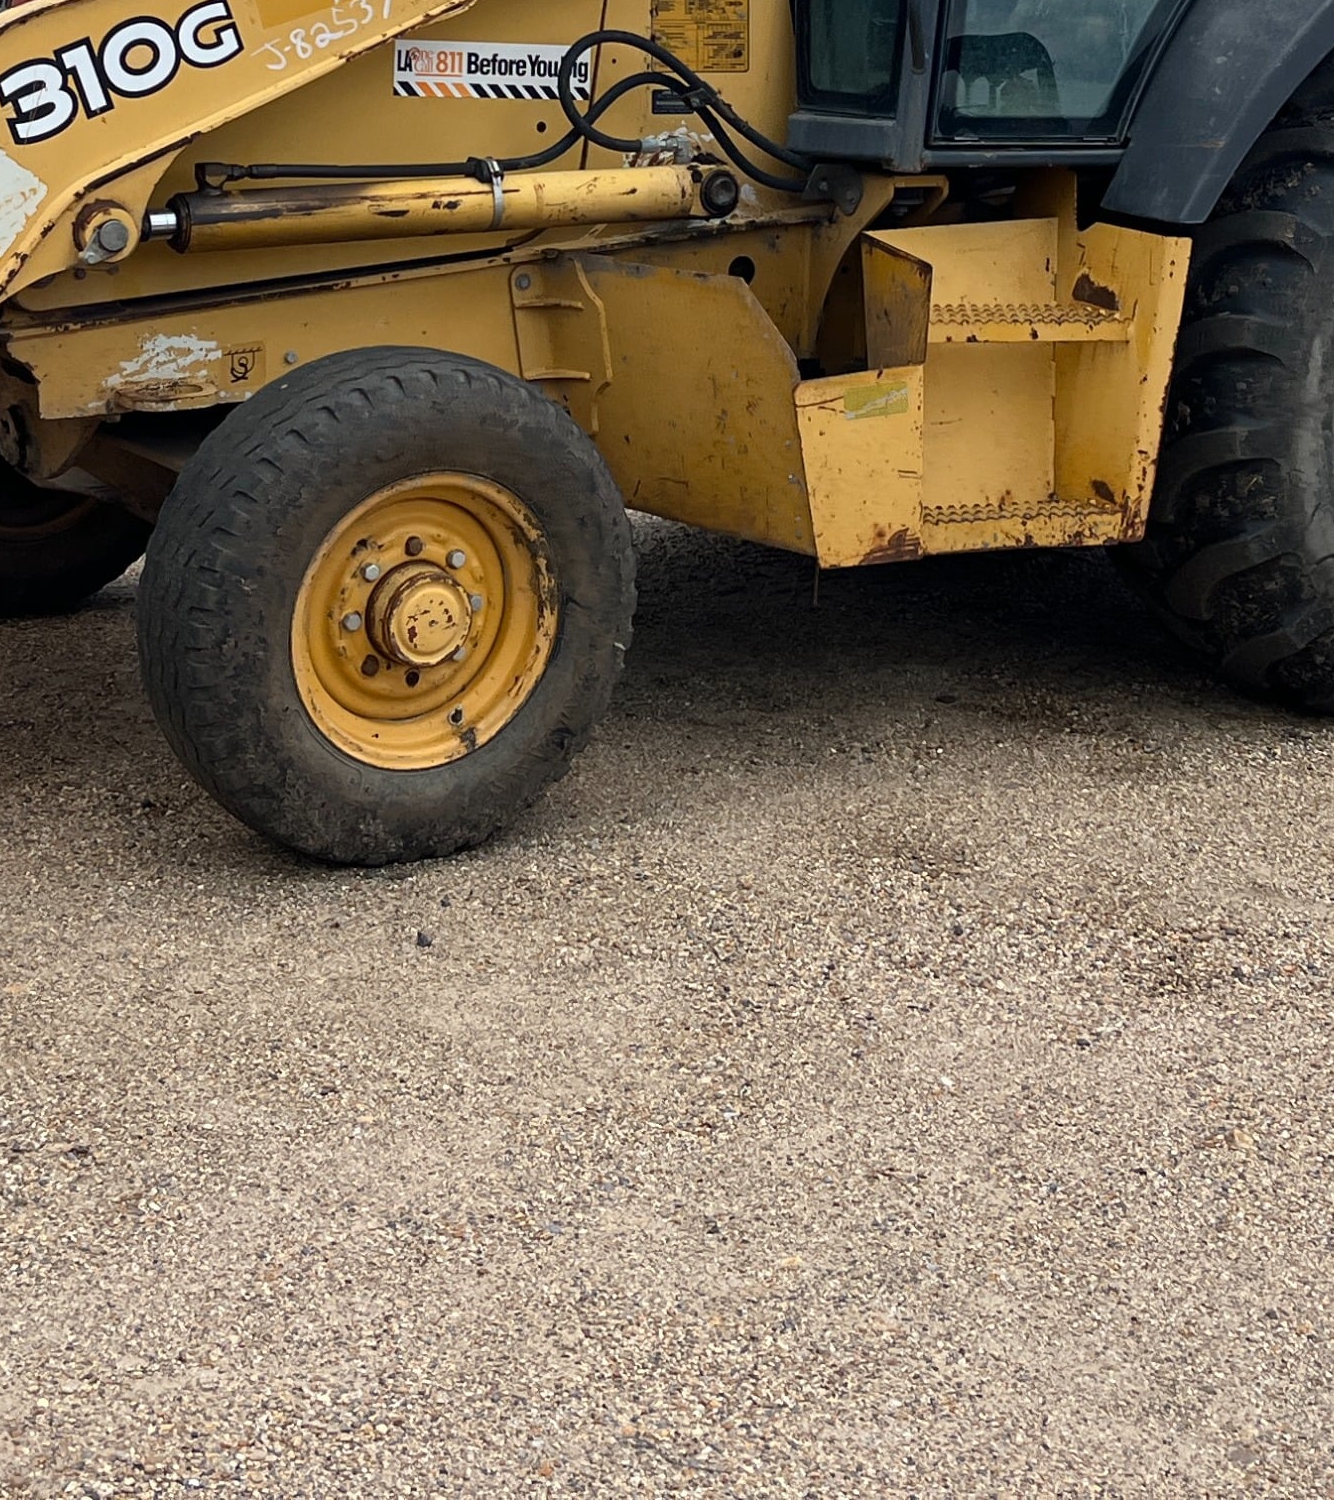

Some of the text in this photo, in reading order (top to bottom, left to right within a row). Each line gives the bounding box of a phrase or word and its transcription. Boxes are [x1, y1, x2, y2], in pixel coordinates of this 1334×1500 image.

[397, 49, 413, 72] LA
[435, 51, 463, 73] 811
[466, 52, 527, 77] Before
[527, 54, 559, 78] You
